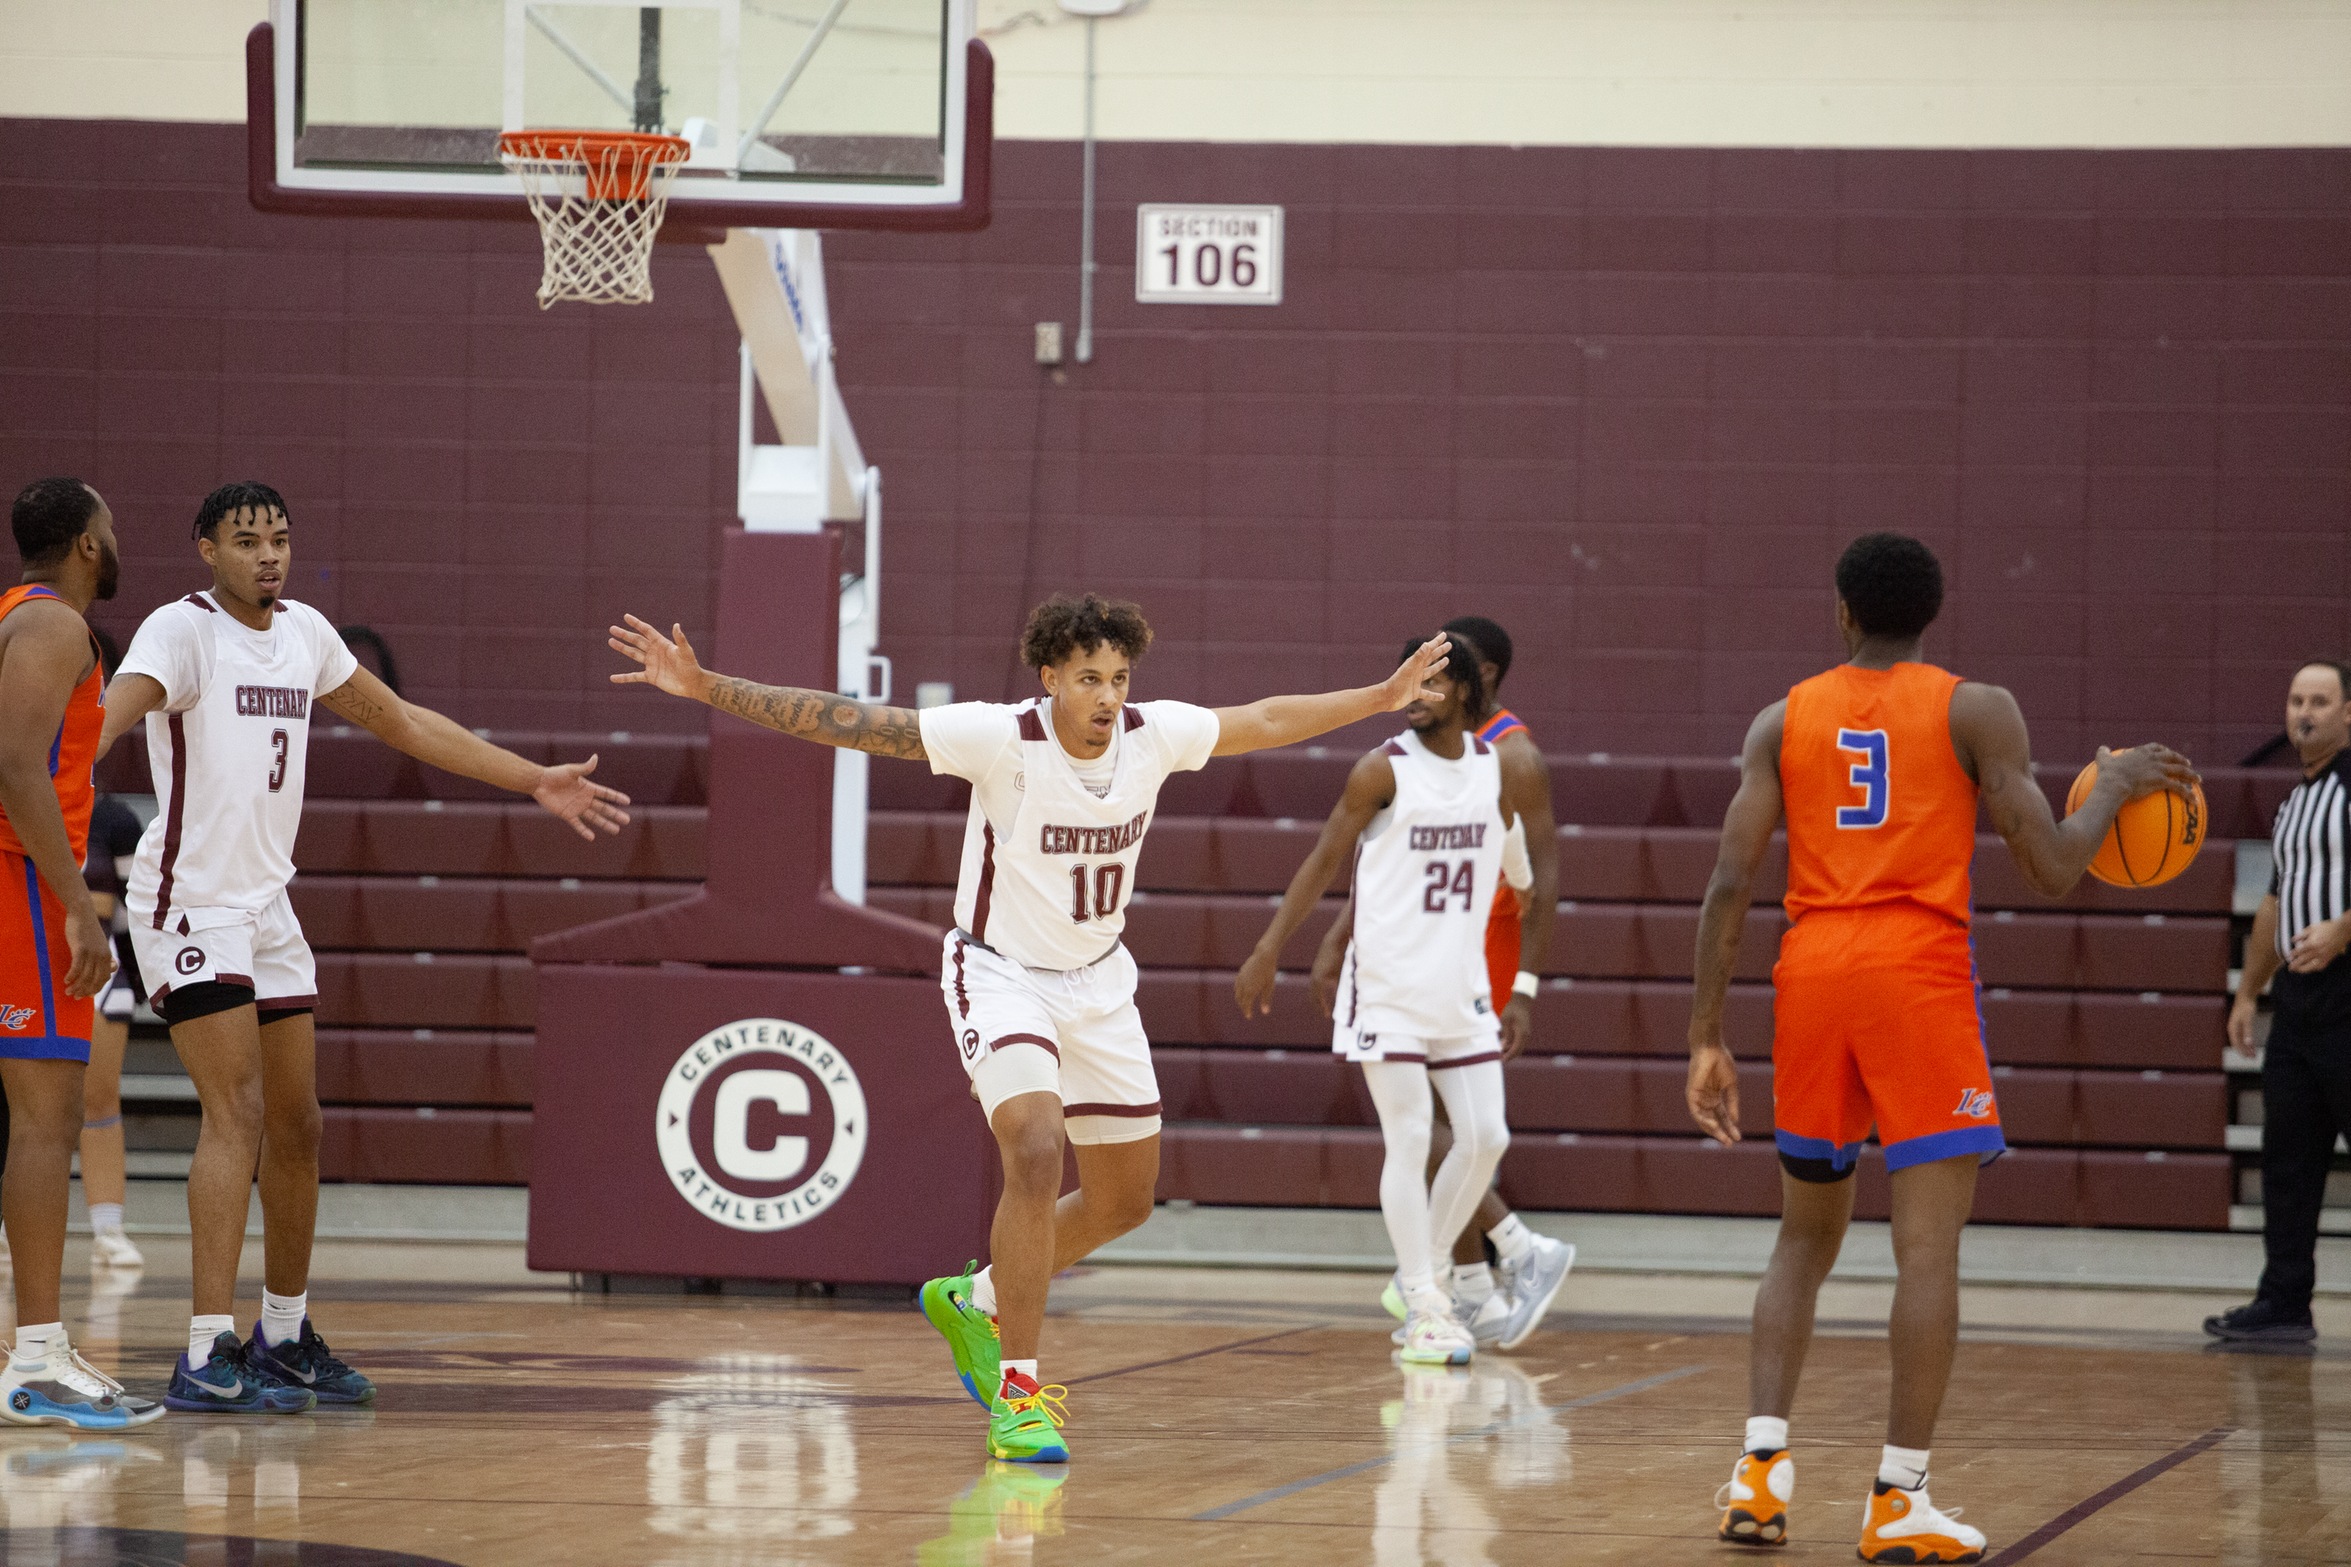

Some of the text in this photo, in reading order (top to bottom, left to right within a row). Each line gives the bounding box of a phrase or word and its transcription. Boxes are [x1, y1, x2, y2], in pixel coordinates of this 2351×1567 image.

[1161, 216, 1258, 237] SECTION
[1161, 243, 1257, 287] 106
[235, 684, 309, 720] CENTENARY
[268, 727, 290, 794] 3
[1835, 727, 1891, 830] 3
[1039, 809, 1149, 855] CENTENARY
[1069, 861, 1126, 925] 10
[1423, 859, 1475, 914] 24
[679, 1026, 848, 1086] CENTENARY
[713, 1068, 811, 1182] C
[678, 1166, 839, 1223] ATHLETICS
